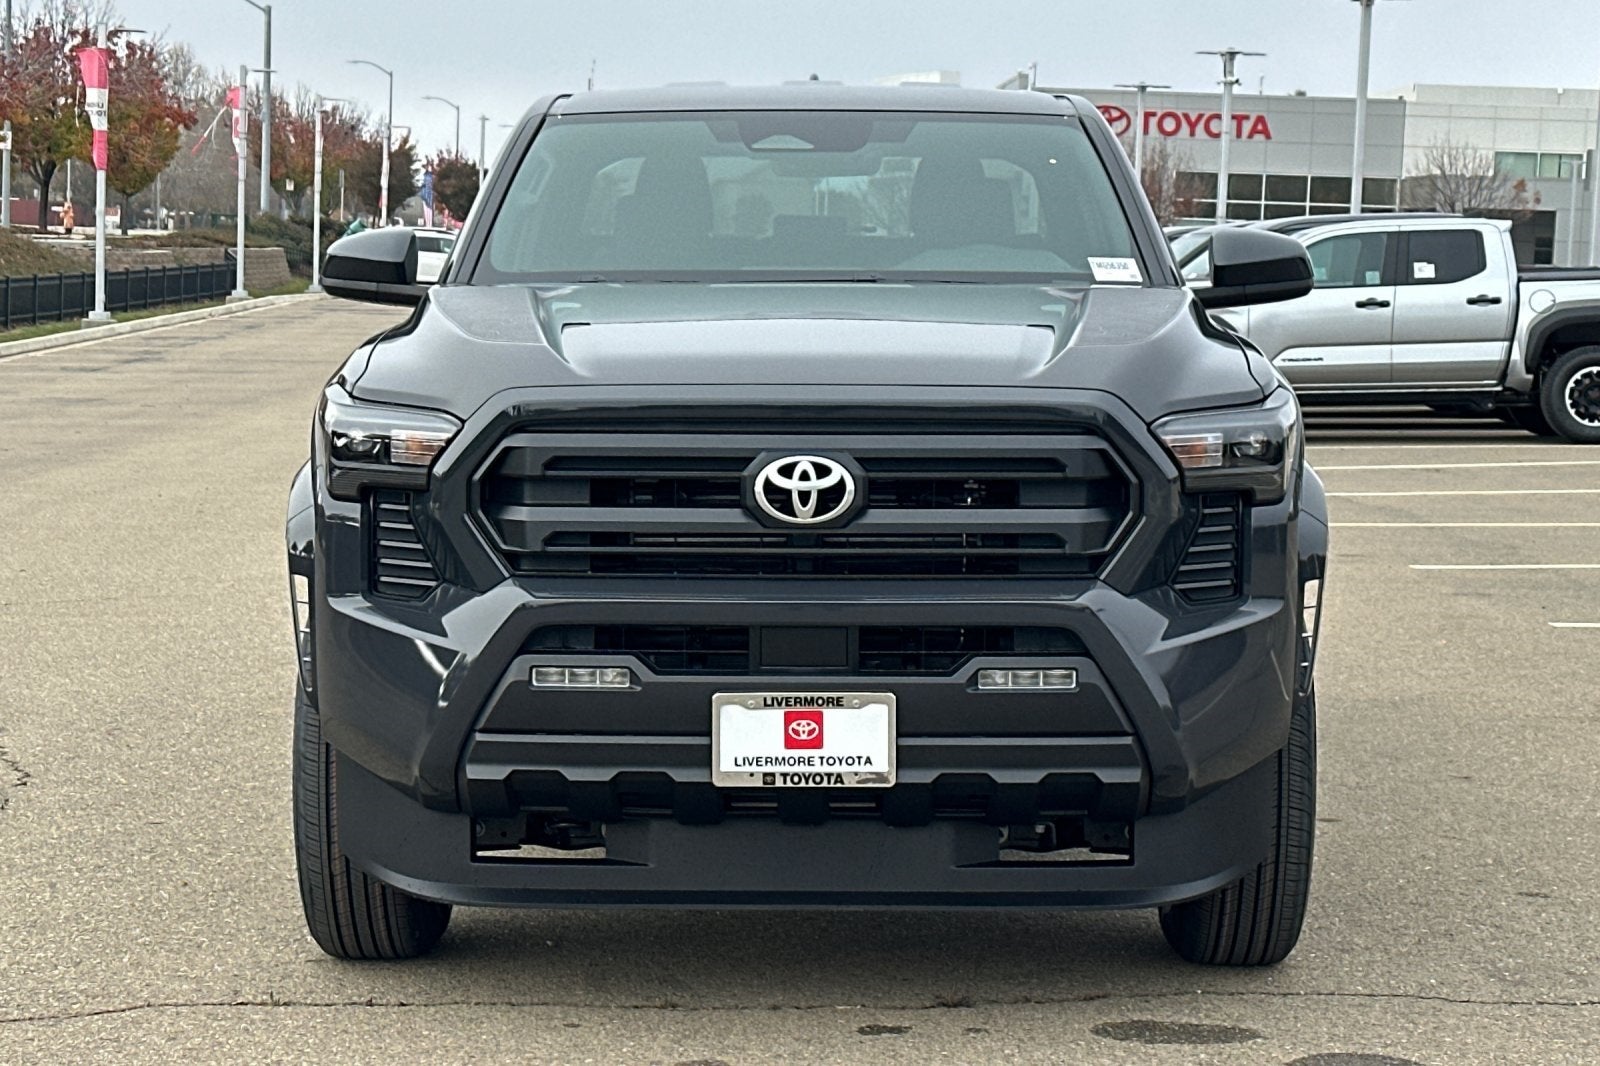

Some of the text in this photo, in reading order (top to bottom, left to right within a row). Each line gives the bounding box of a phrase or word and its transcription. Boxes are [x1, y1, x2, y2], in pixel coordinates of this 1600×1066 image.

[1141, 111, 1272, 140] TOYOTA
[763, 696, 844, 707] LIVERMORE
[734, 755, 873, 767] LIVERMORE TOYOTA
[780, 772, 845, 785] TOYOTA
